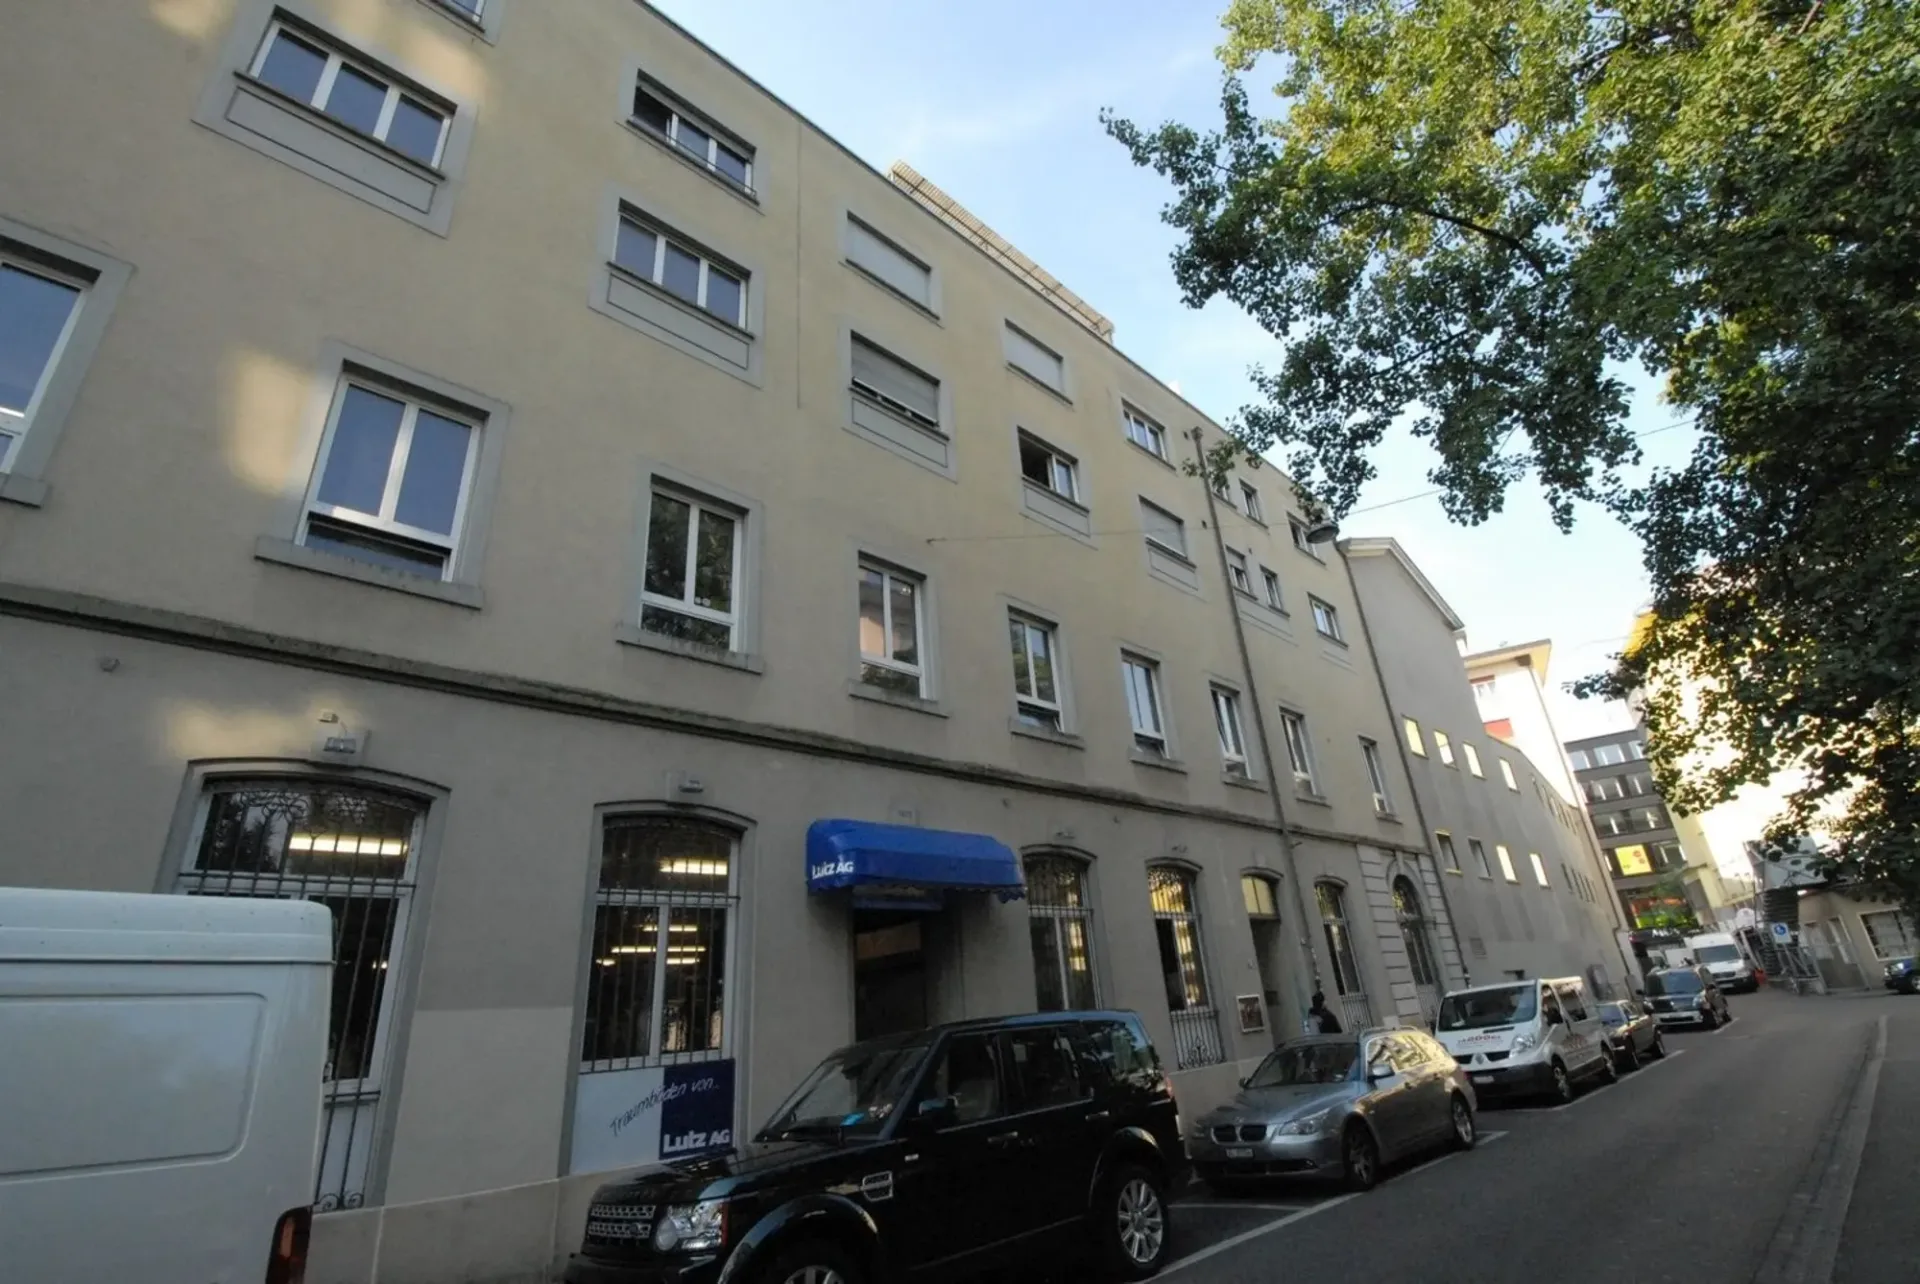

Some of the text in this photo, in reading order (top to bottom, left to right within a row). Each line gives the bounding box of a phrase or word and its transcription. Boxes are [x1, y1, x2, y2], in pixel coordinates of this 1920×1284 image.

[836, 861, 854, 874] AG
[663, 1128, 730, 1153] Lutz AG
